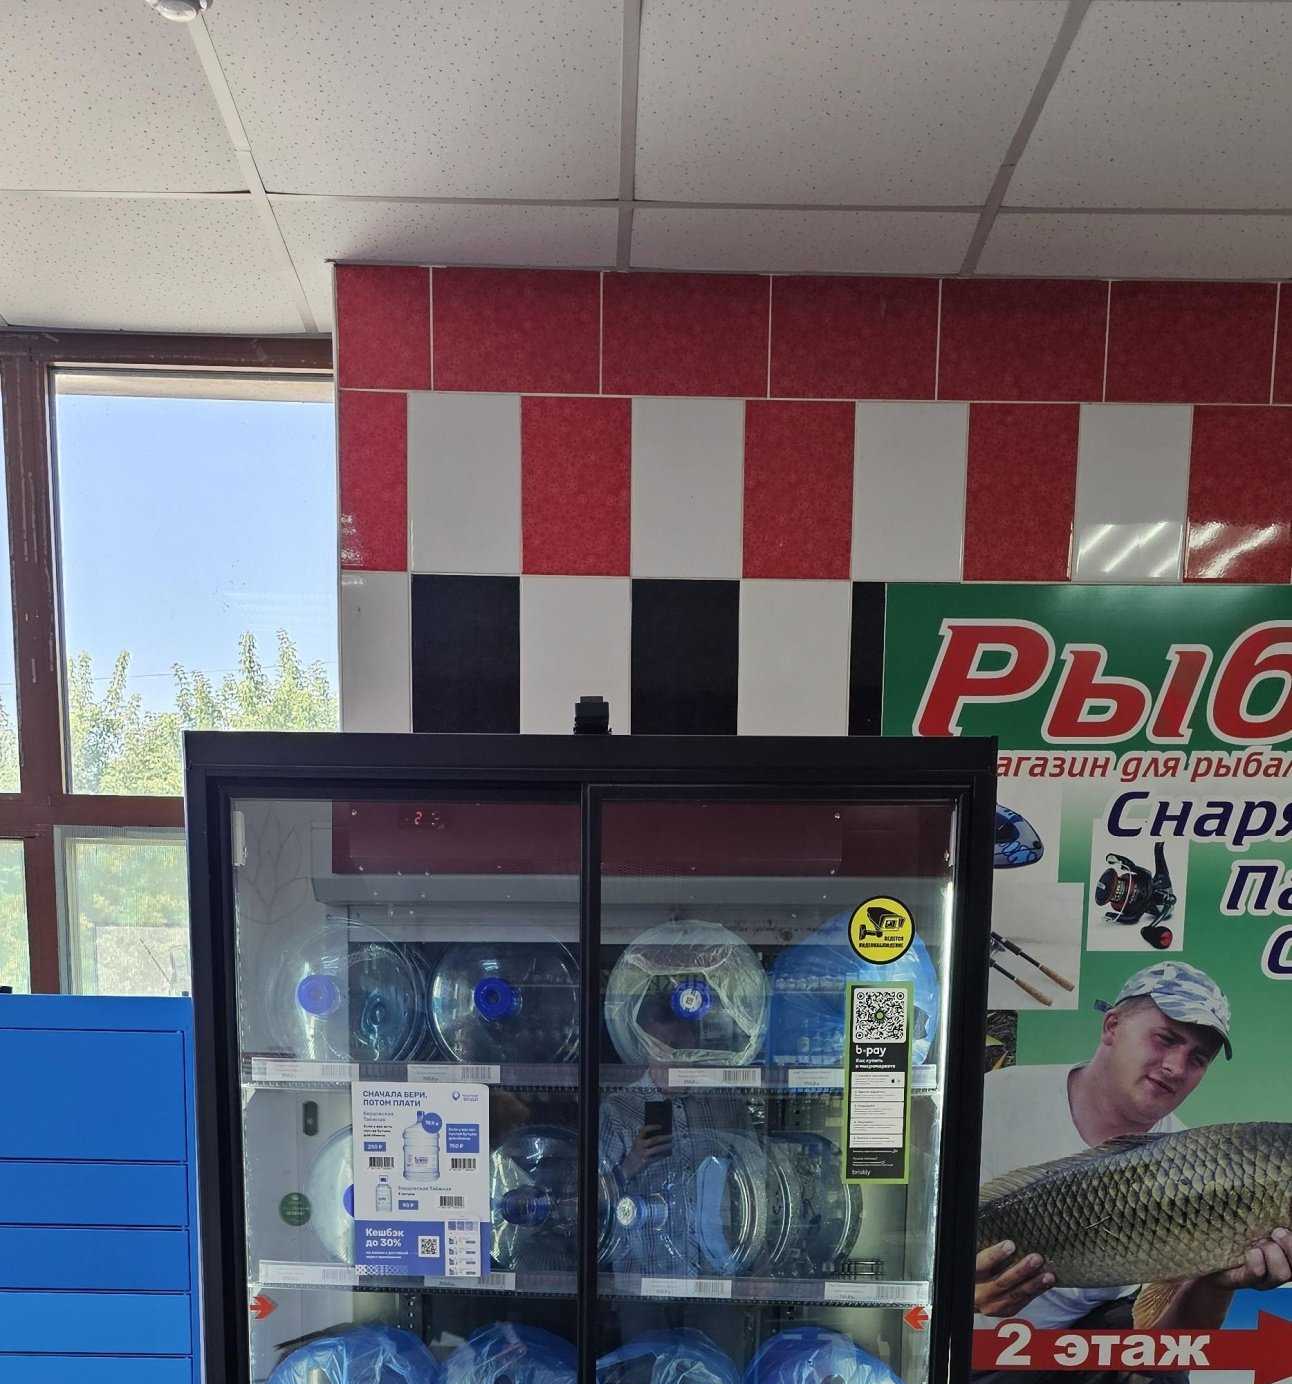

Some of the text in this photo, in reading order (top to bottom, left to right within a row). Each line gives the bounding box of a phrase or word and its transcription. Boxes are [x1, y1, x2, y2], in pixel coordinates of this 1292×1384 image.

[913, 619, 1292, 744] Рыб
[1120, 756, 1181, 782] для
[855, 1044, 887, 1058] b-pay
[362, 1090, 402, 1098] СНАЧАЛА
[365, 1228, 404, 1237] Кешбэк
[365, 1239, 402, 1247] до 30%
[995, 1322, 1211, 1367] 2 этаж
